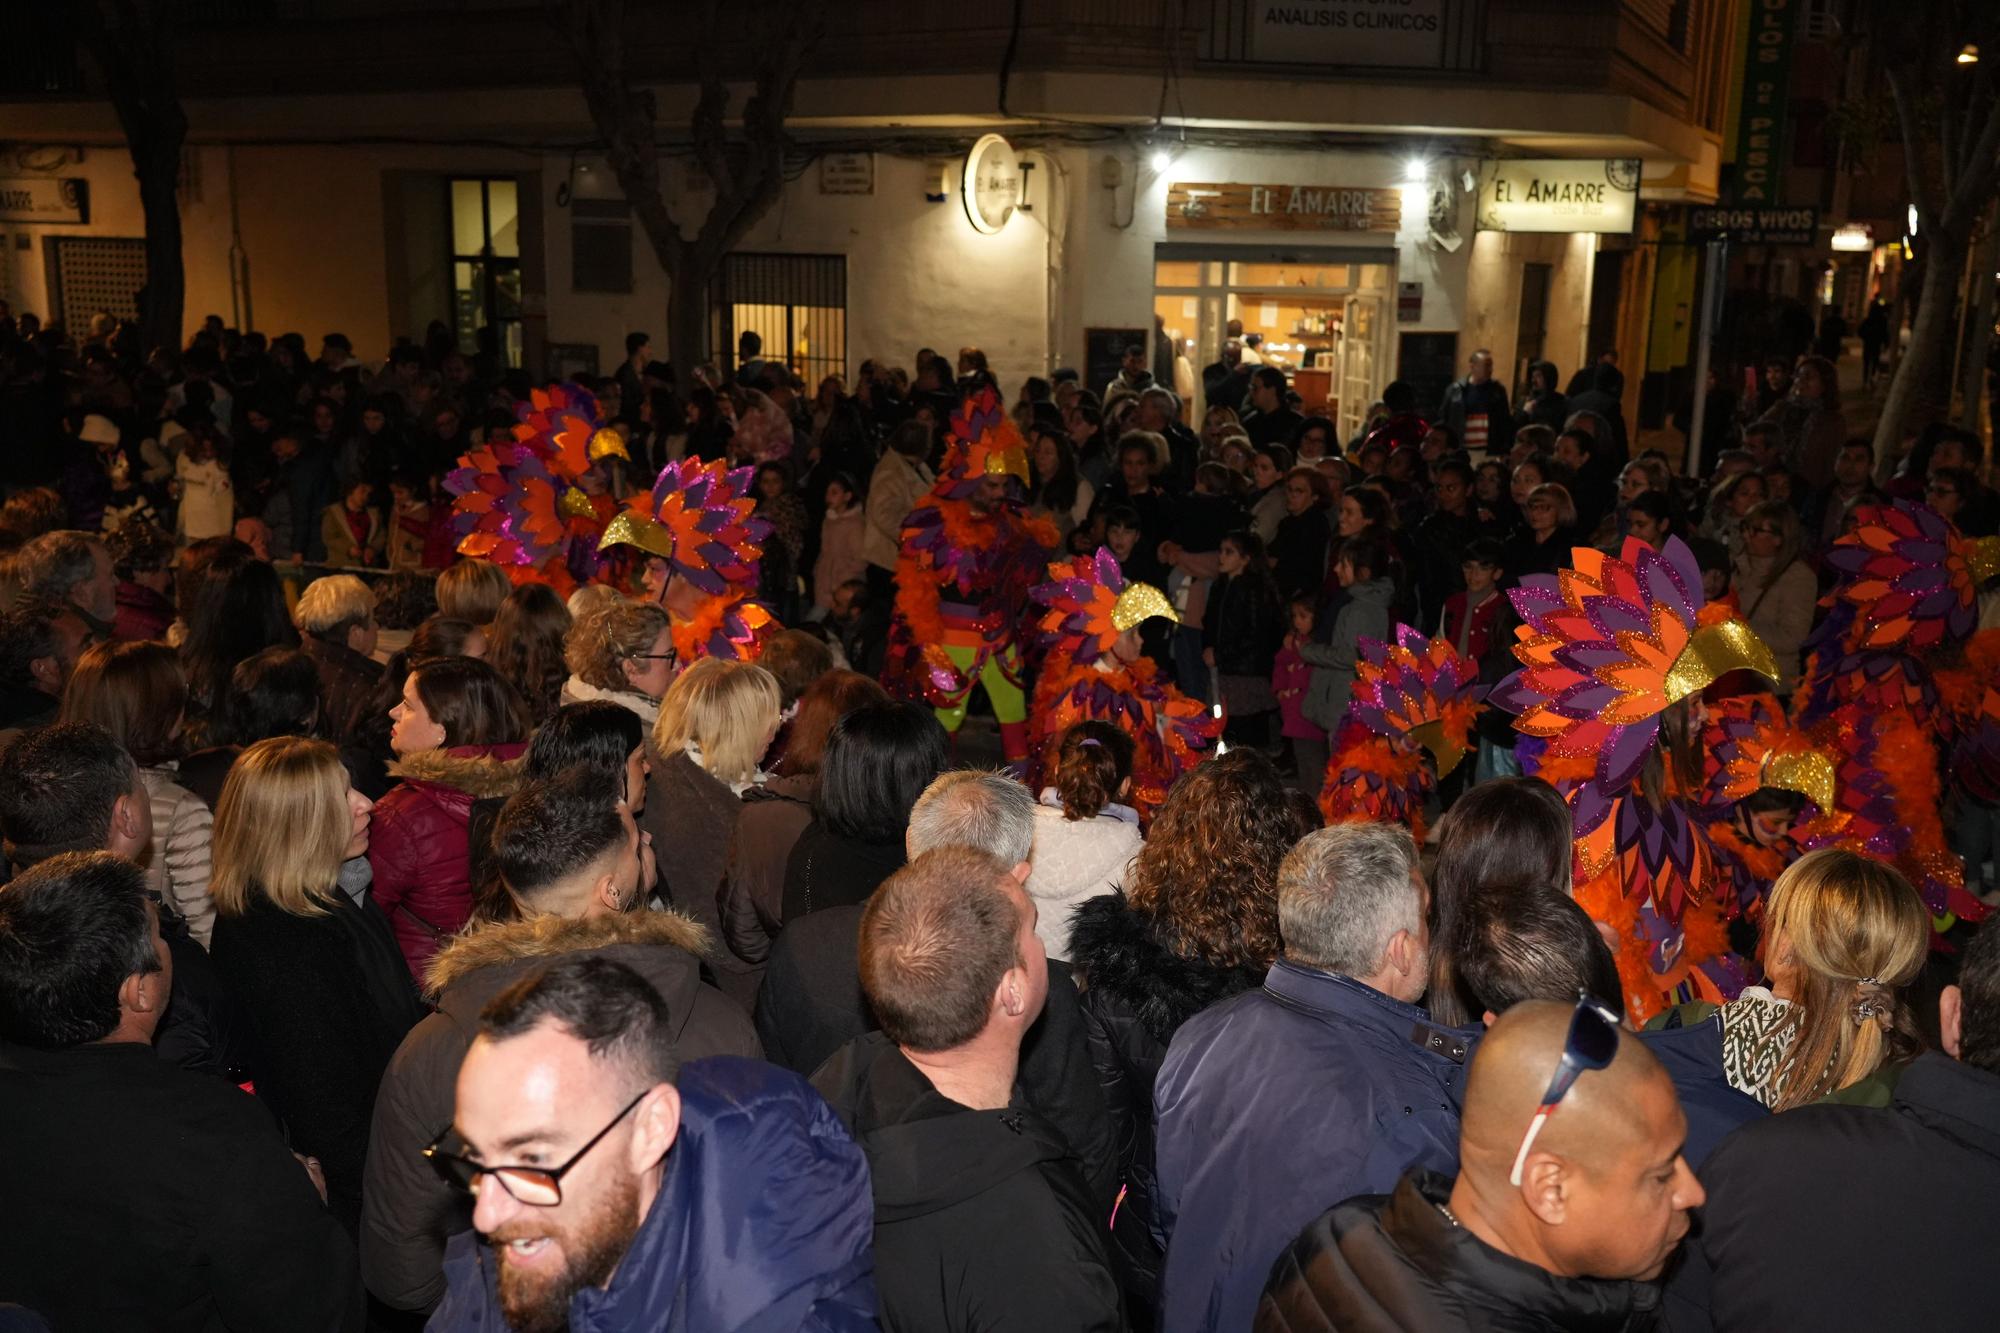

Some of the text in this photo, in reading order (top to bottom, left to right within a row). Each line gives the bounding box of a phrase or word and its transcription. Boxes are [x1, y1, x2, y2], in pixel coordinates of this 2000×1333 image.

[1264, 8, 1438, 32] ANALISIS CLINICOS
[1743, 117, 1774, 200] PESCA
[1250, 186, 1374, 215] EL AMARRE
[1495, 179, 1606, 203] EL AMARRE
[1692, 209, 1814, 230] CEBOS VIVOS
